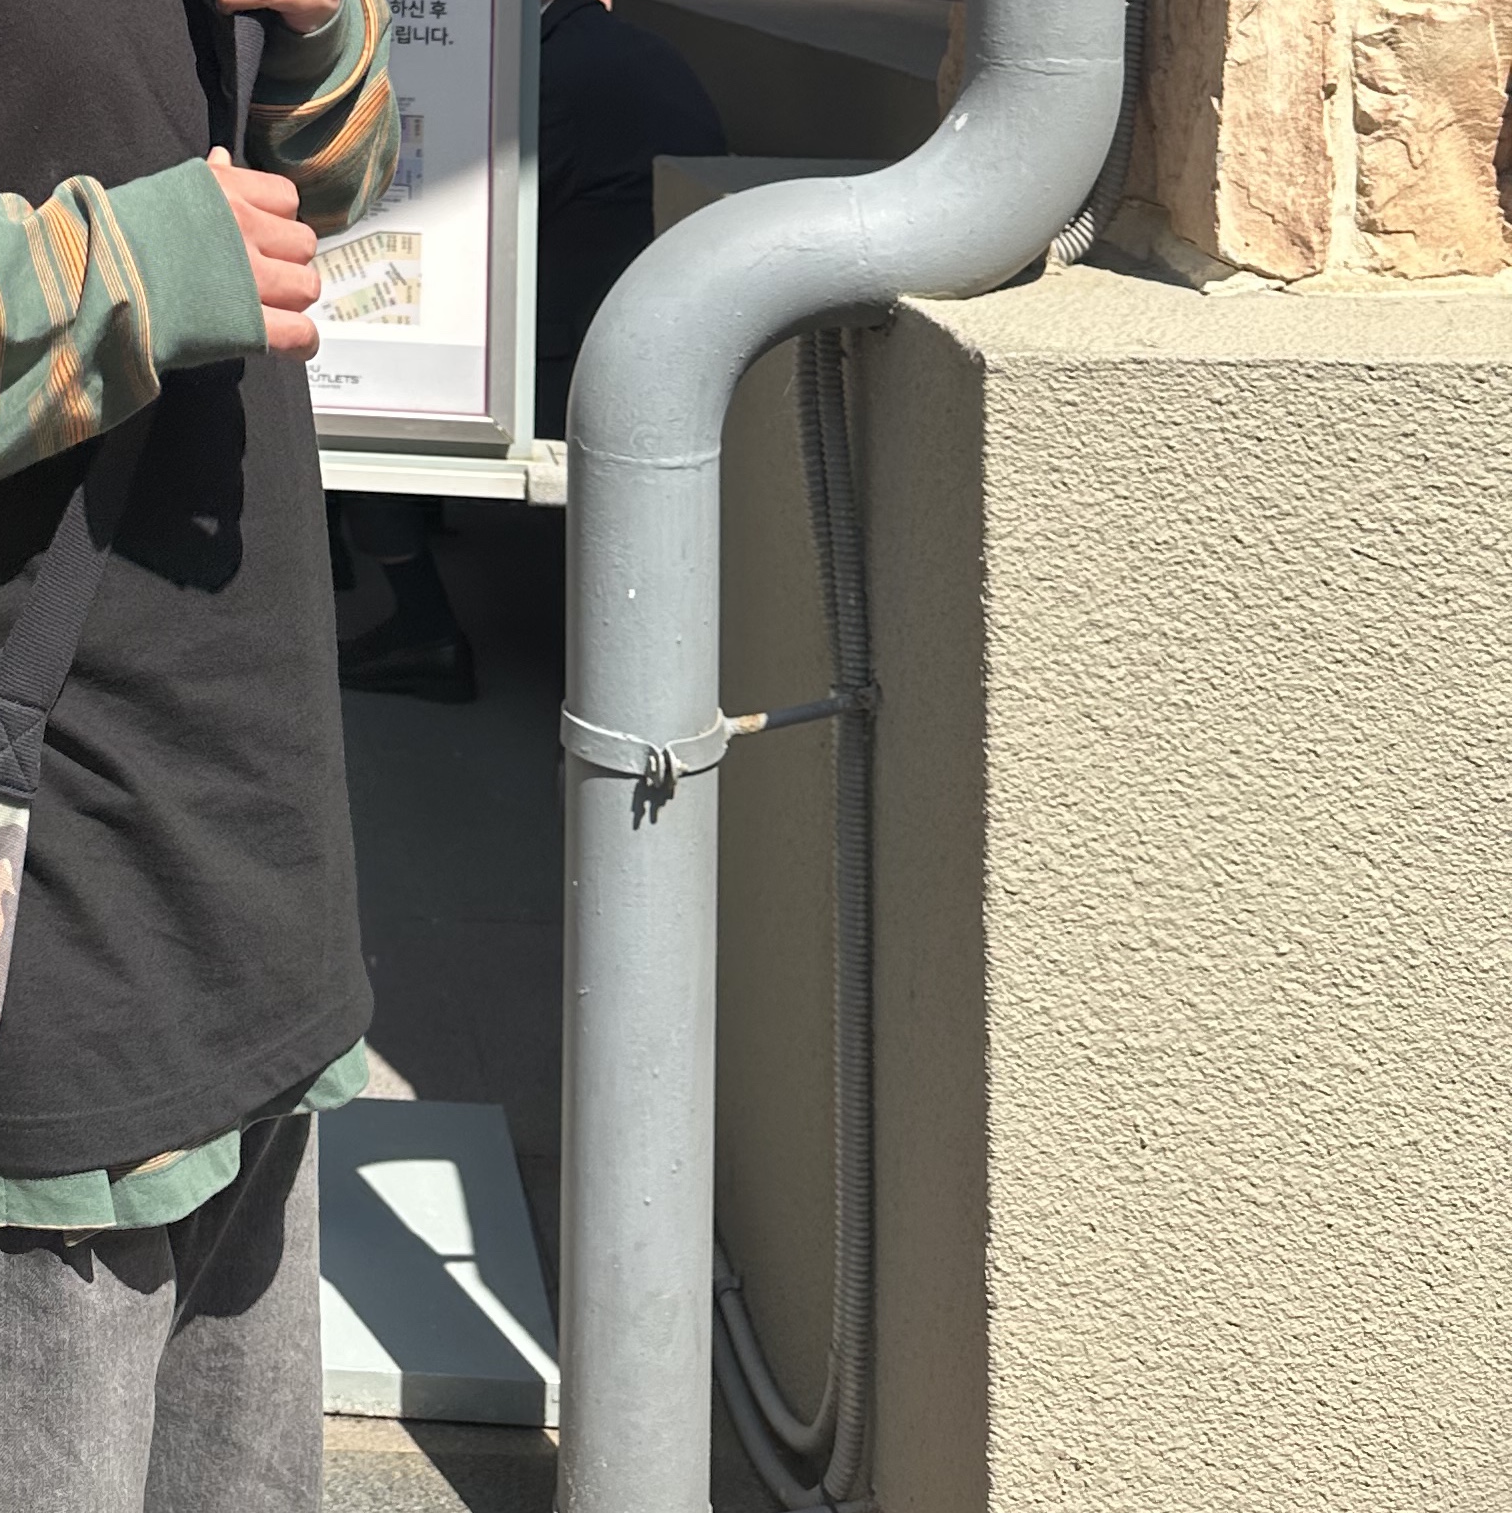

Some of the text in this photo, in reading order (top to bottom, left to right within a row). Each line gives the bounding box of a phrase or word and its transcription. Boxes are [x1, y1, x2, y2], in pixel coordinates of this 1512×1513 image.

[429, 0, 447, 20] 후
[391, 25, 454, 46] 립니다.
[308, 373, 360, 385] UTLETS
